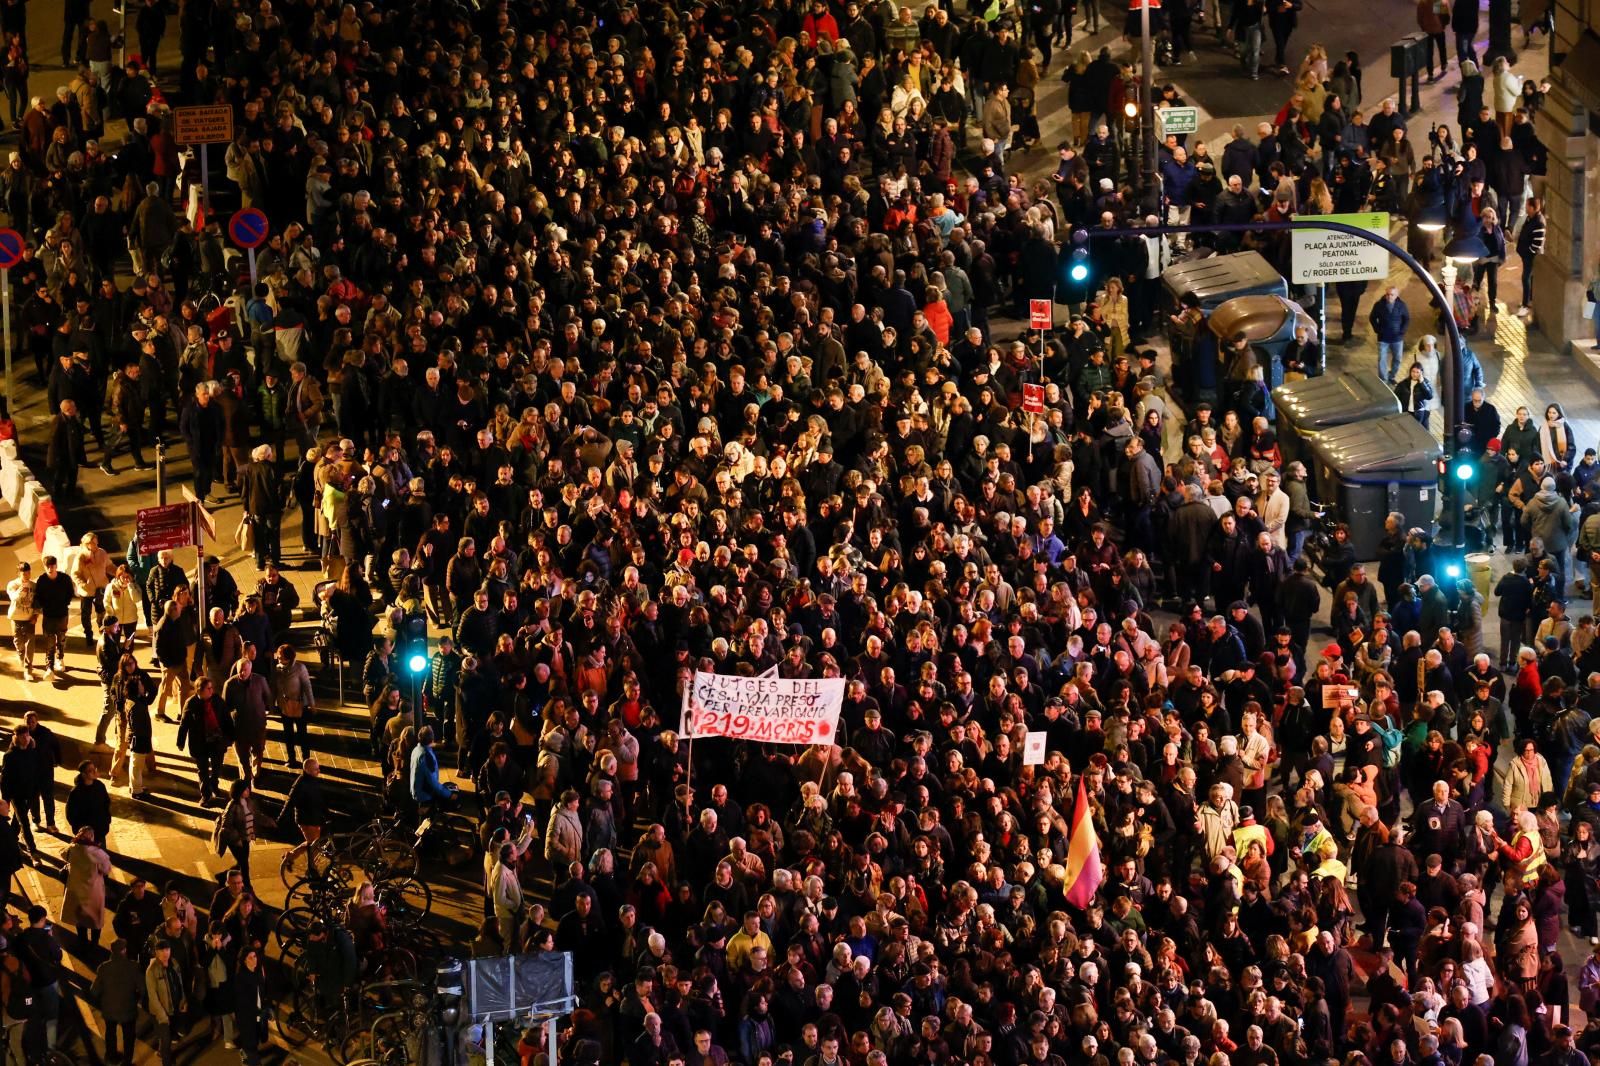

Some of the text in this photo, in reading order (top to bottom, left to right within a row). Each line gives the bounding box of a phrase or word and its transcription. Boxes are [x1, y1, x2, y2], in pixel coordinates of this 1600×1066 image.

[1304, 242, 1327, 250] PLAÇA
[1322, 250, 1358, 258] PEATONAL
[1303, 270, 1312, 278] C/
[1313, 268, 1338, 276] ROGER
[1352, 266, 1378, 274] LLORIA
[707, 675, 822, 694] JUTGES DEL
[704, 700, 730, 712] PER
[700, 712, 750, 736] 219
[754, 720, 815, 739] MORTS
